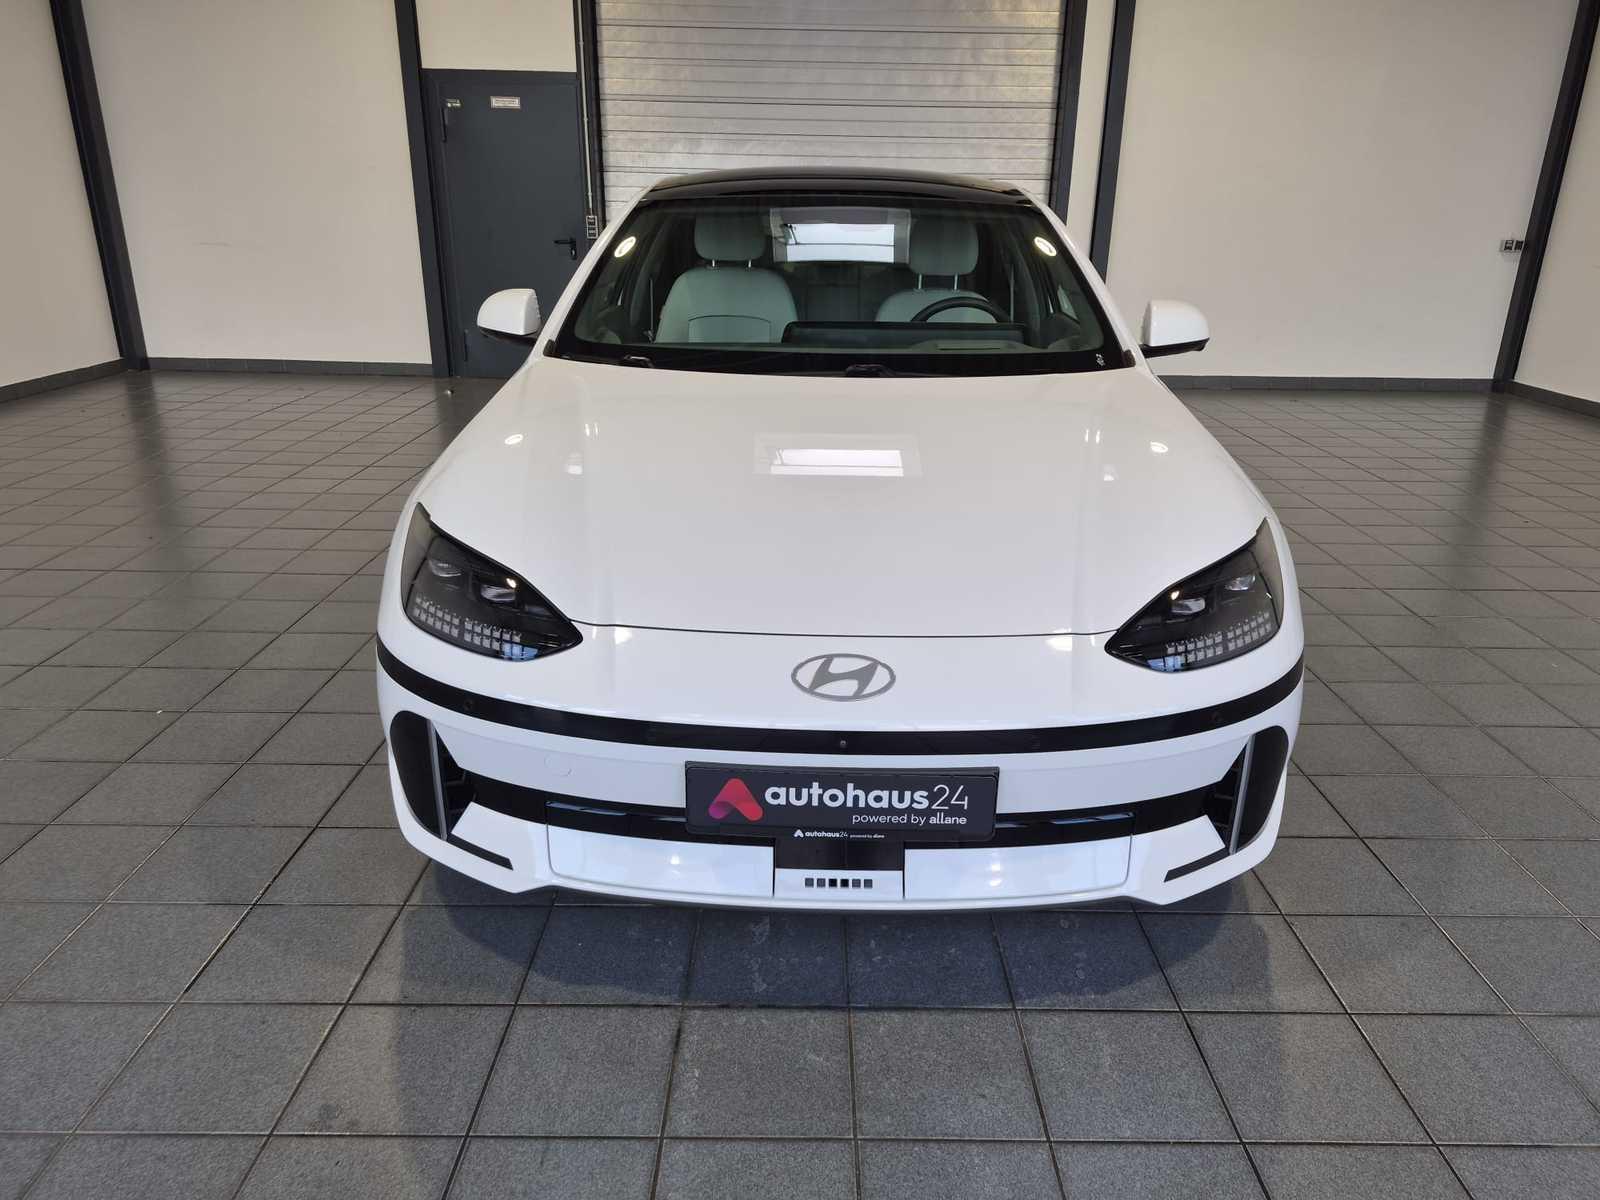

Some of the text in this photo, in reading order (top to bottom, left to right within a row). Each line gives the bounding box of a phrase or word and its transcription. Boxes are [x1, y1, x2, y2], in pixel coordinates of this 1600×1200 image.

[764, 782, 969, 810] autohaus24
[852, 813, 968, 826] powered by allane
